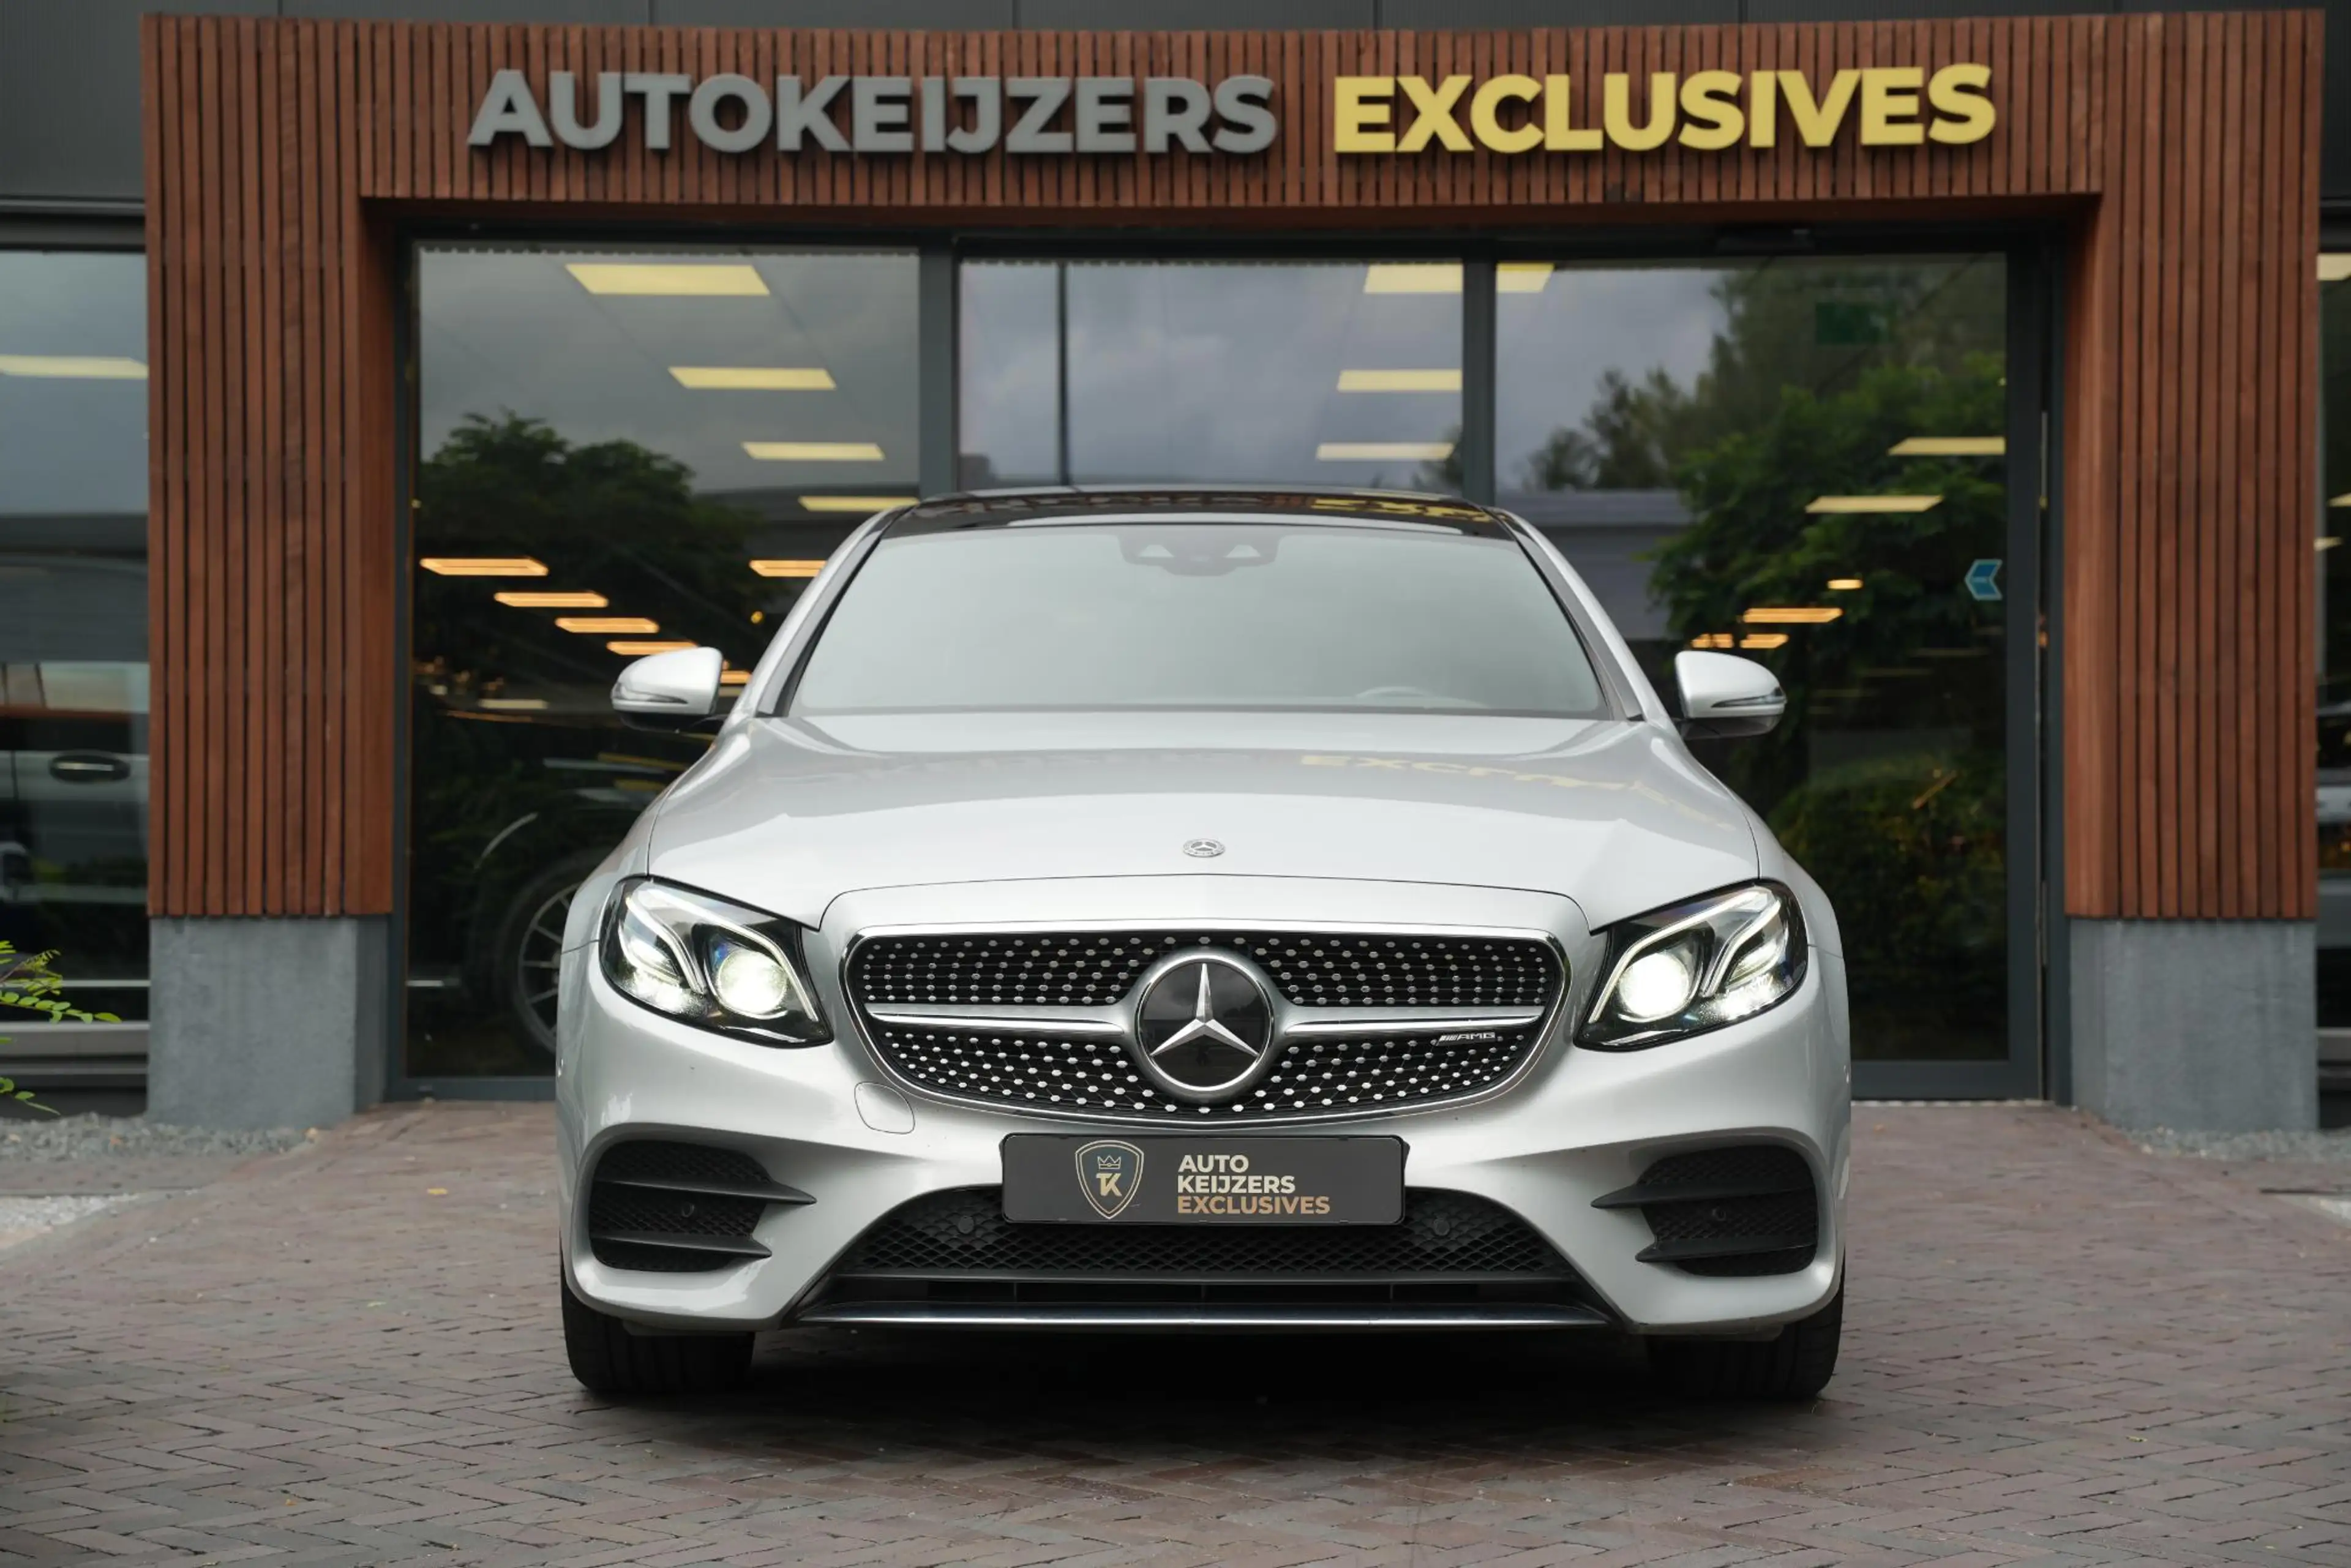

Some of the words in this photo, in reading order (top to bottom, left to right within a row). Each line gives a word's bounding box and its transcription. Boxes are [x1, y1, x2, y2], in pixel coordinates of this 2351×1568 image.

[468, 69, 1277, 153] AUTOKEIJZERS
[1334, 63, 1997, 154] EXCLUSIVES
[1457, 1032, 1496, 1041] AMG
[1178, 1154, 1250, 1174] AUTO
[1177, 1175, 1296, 1194] KEIJZERS
[1177, 1196, 1331, 1215] EXCLUSIVES
